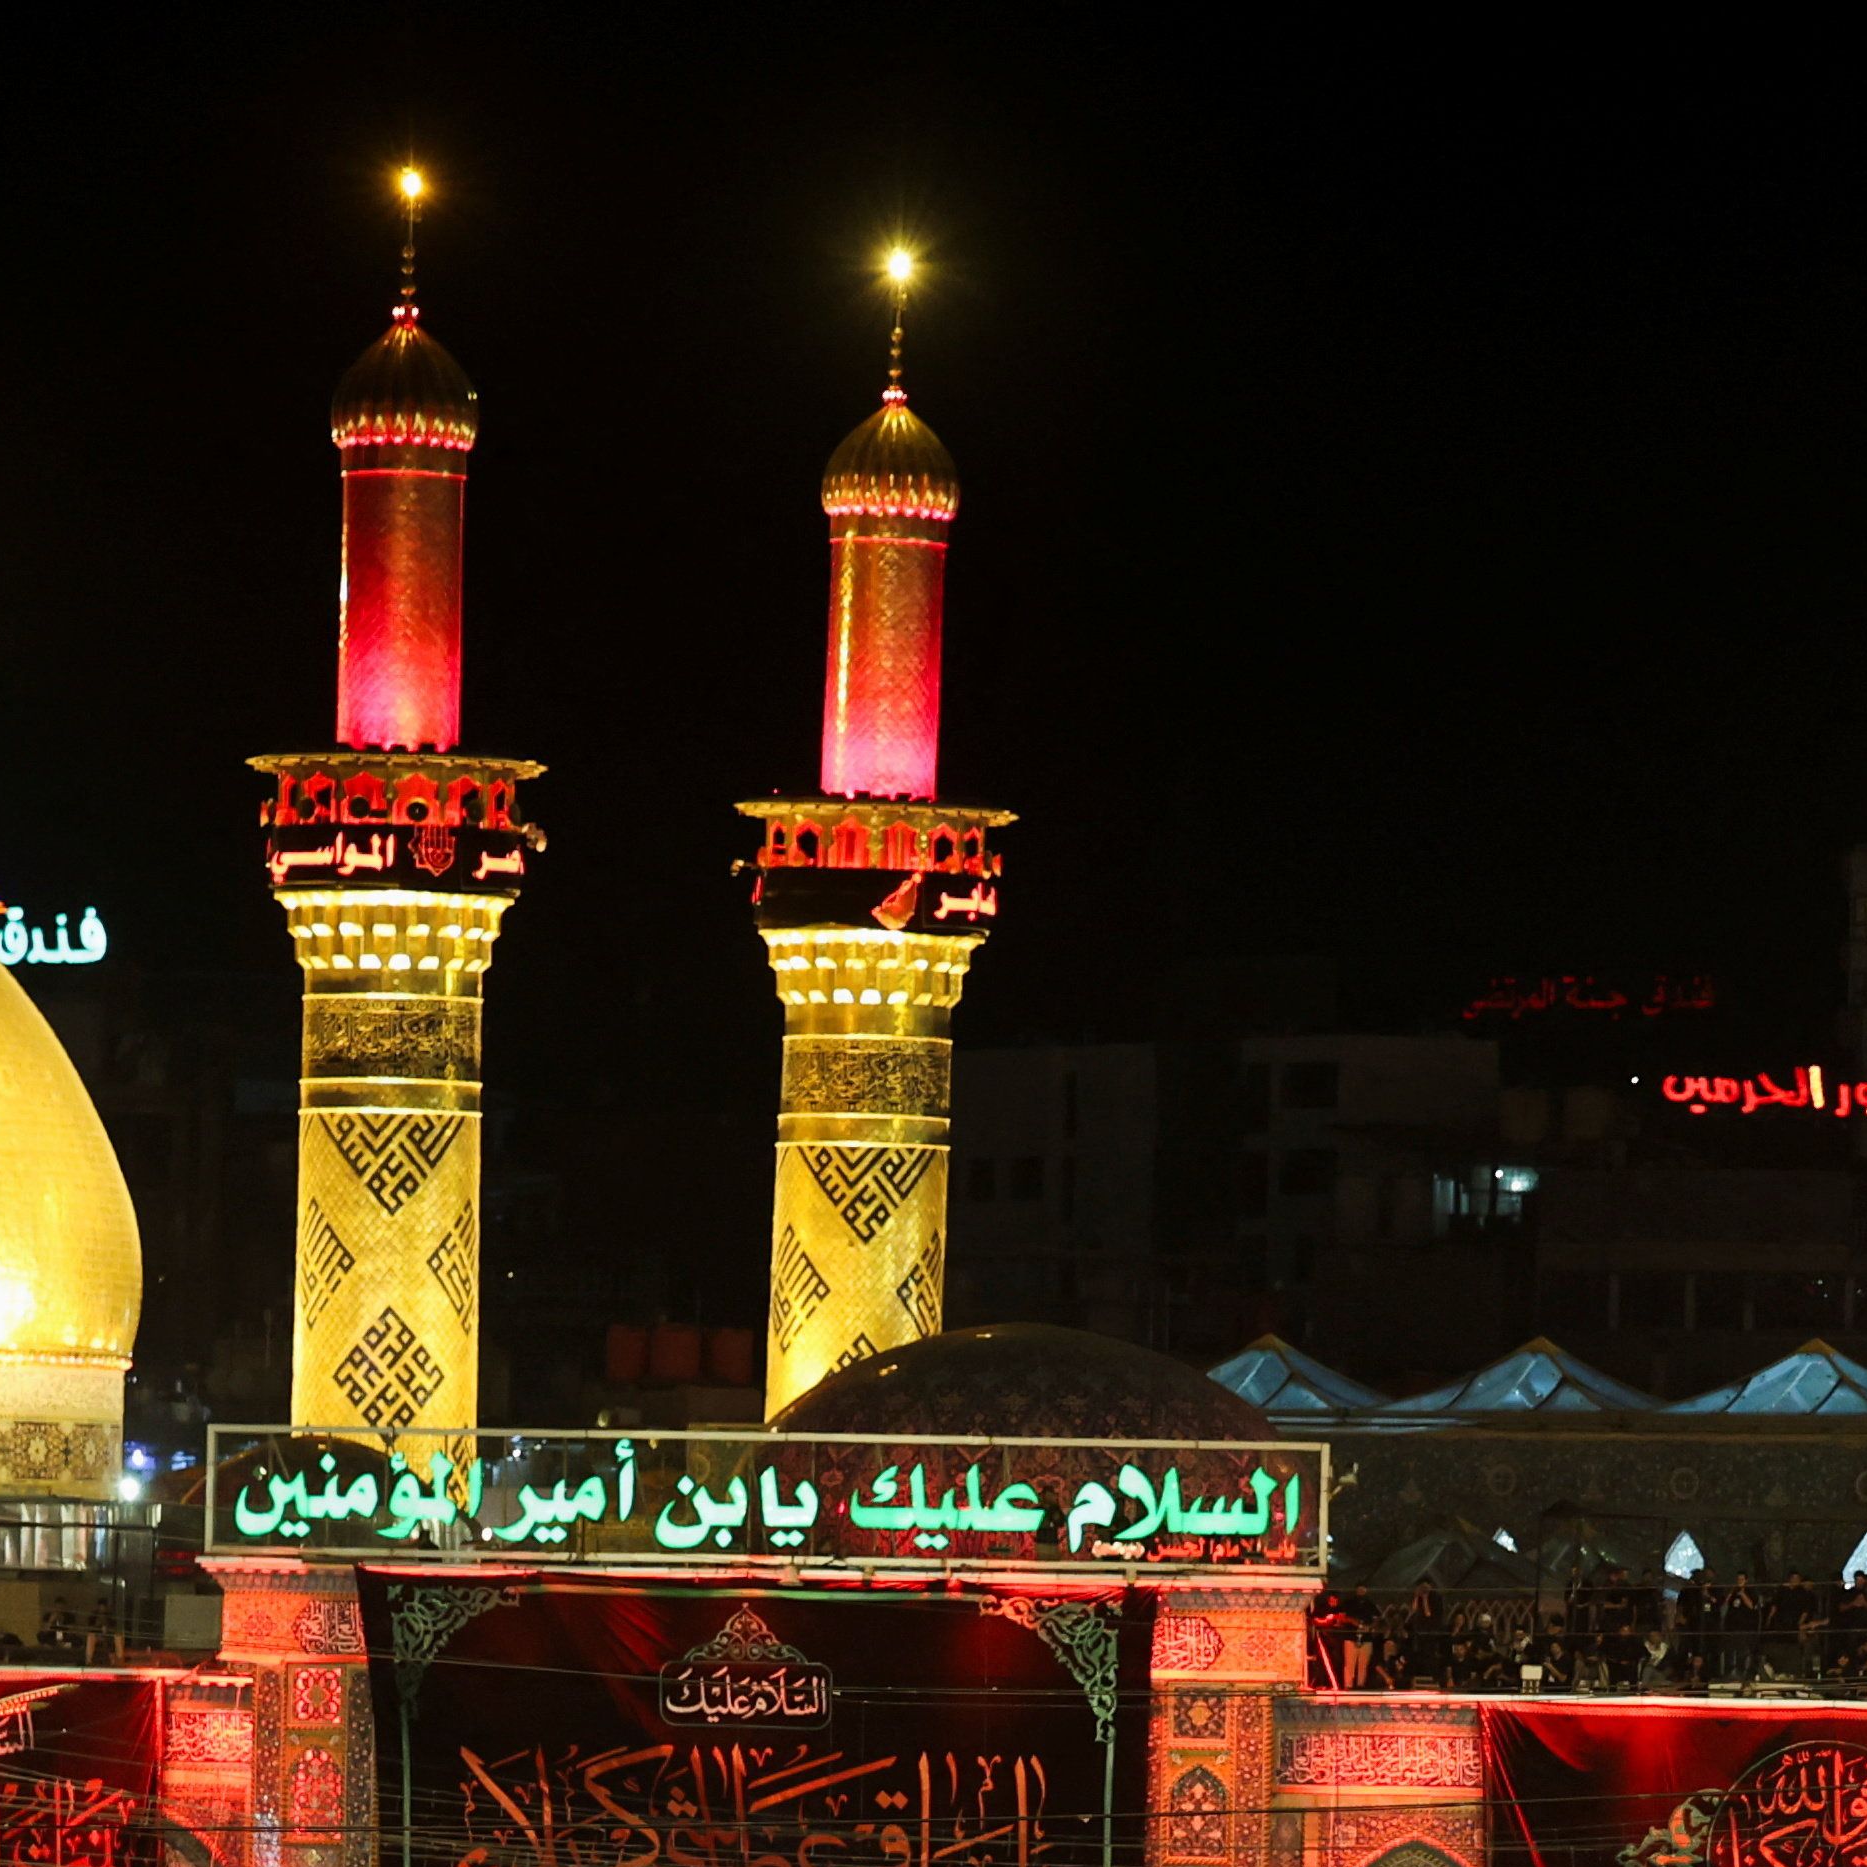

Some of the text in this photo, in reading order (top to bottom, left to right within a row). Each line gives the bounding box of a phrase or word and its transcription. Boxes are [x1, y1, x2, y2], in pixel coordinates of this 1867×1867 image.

[234, 1449, 485, 1540] المؤمنين
[493, 1437, 635, 1544] أمير
[849, 1462, 1045, 1552] عليك
[1067, 1463, 1300, 1554] السلام
